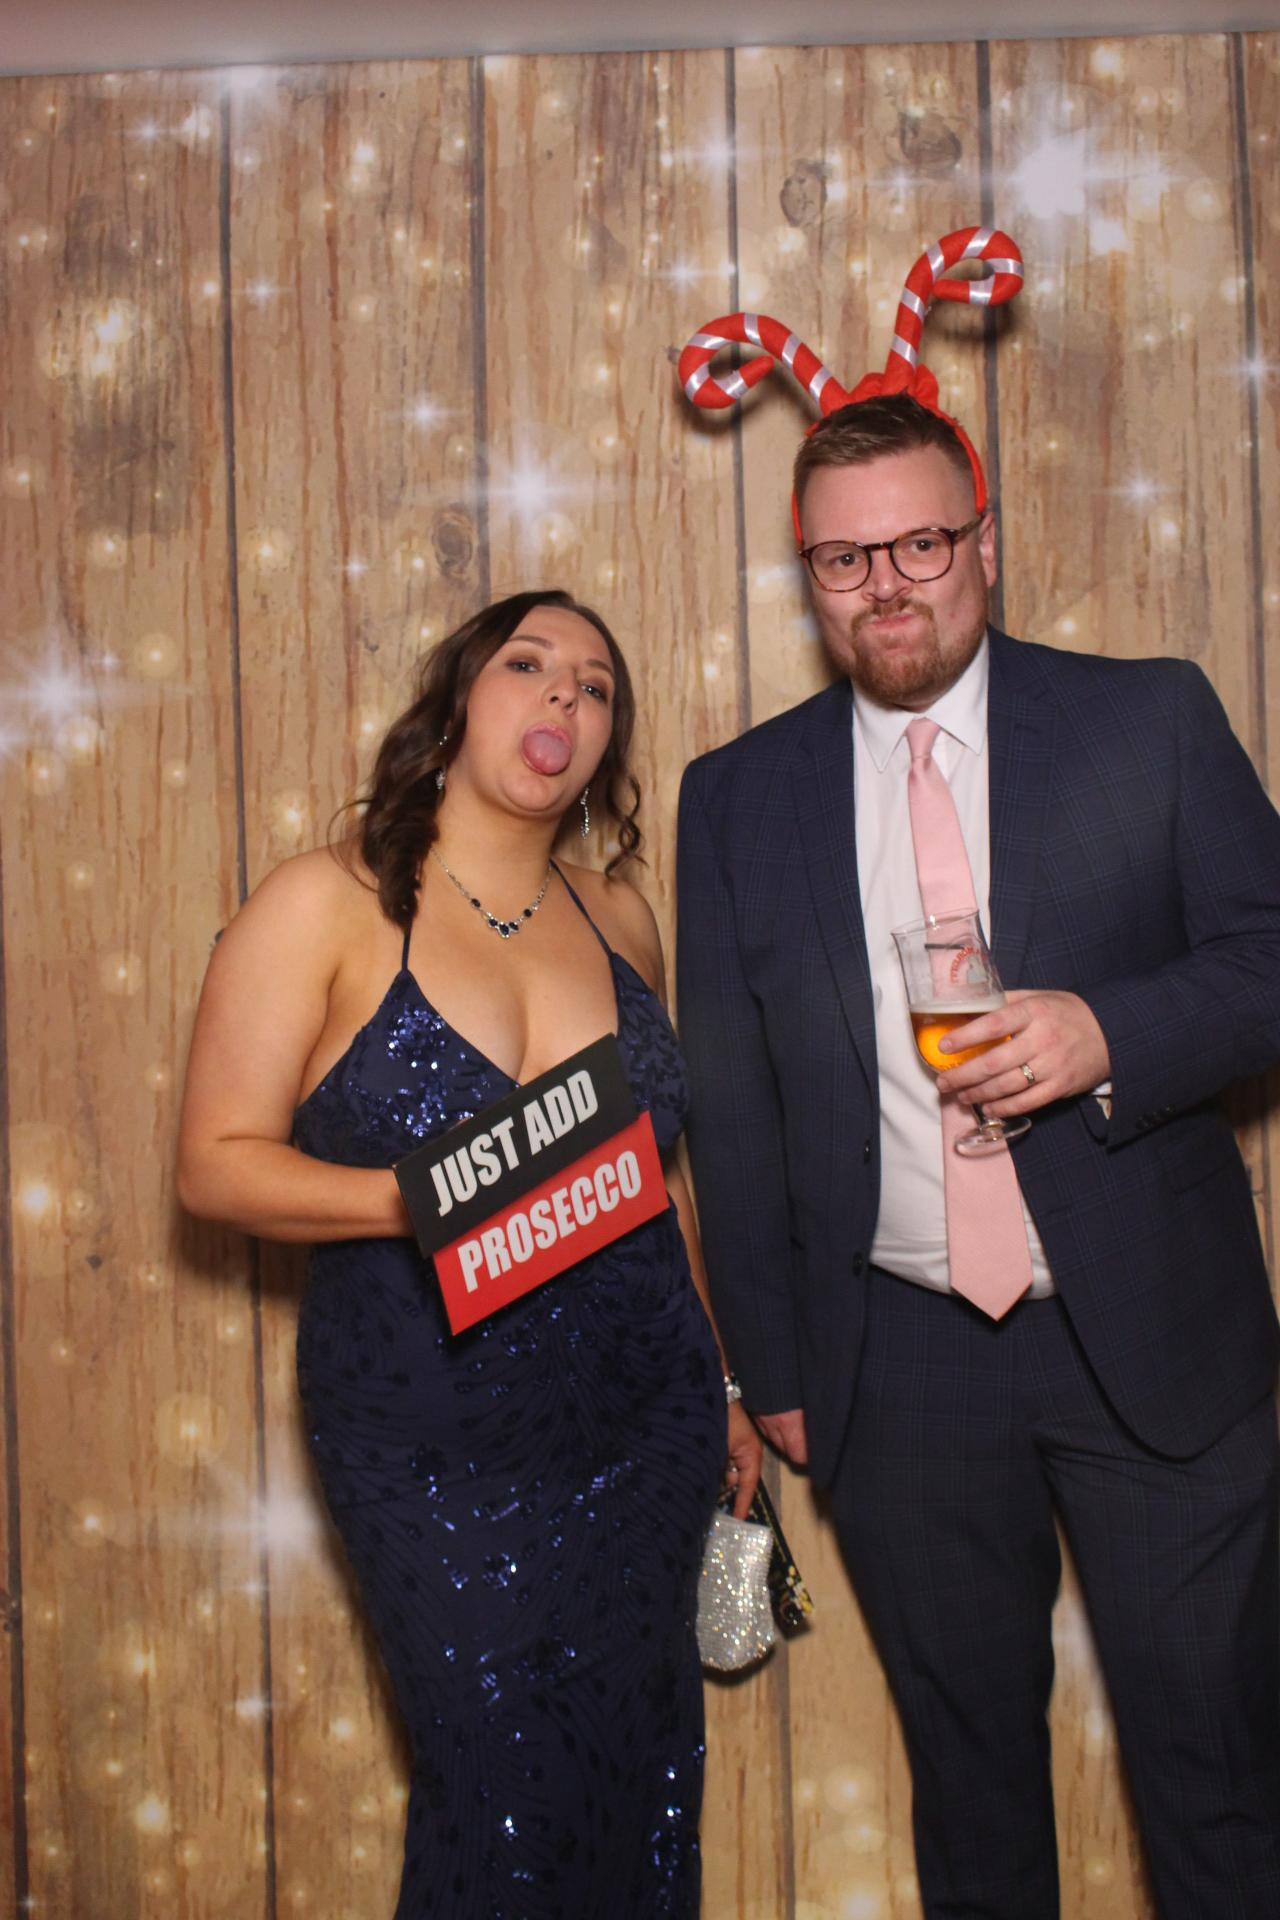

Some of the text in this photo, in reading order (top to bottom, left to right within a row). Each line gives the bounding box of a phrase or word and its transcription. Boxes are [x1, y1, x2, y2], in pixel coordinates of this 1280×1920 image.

[430, 1069, 599, 1217] JUST ADD
[457, 1150, 642, 1294] PROSECCO
